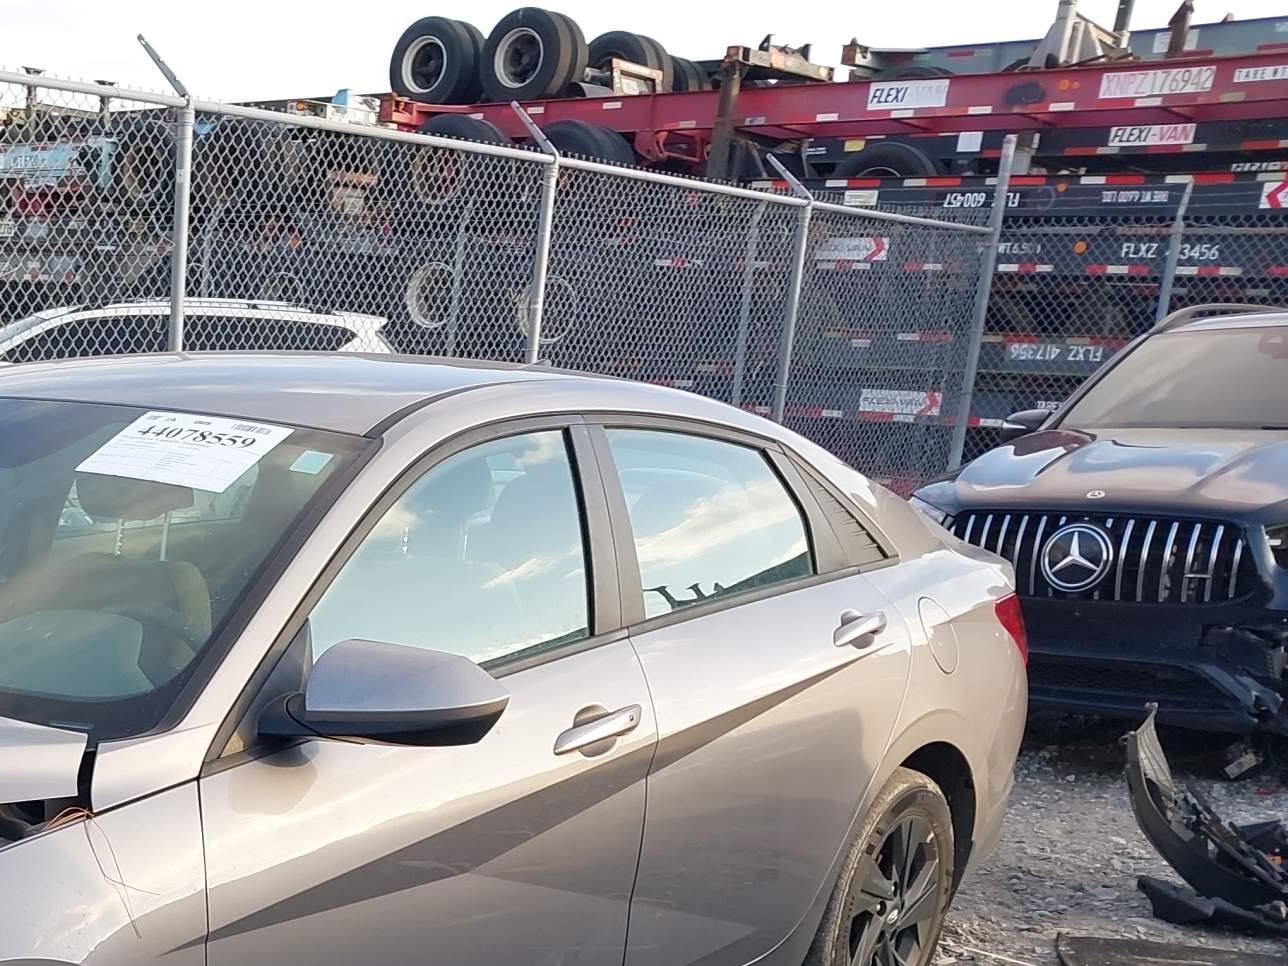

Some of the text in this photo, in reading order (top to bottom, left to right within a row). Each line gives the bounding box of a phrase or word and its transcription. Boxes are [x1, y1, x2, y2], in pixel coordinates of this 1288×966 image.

[869, 86, 909, 104] FLEXI
[1111, 123, 1193, 143] FLEXI-VAN
[1120, 243, 1159, 259] FLXZ
[1067, 345, 1104, 362] FLXZ
[137, 425, 257, 448] 44078559
